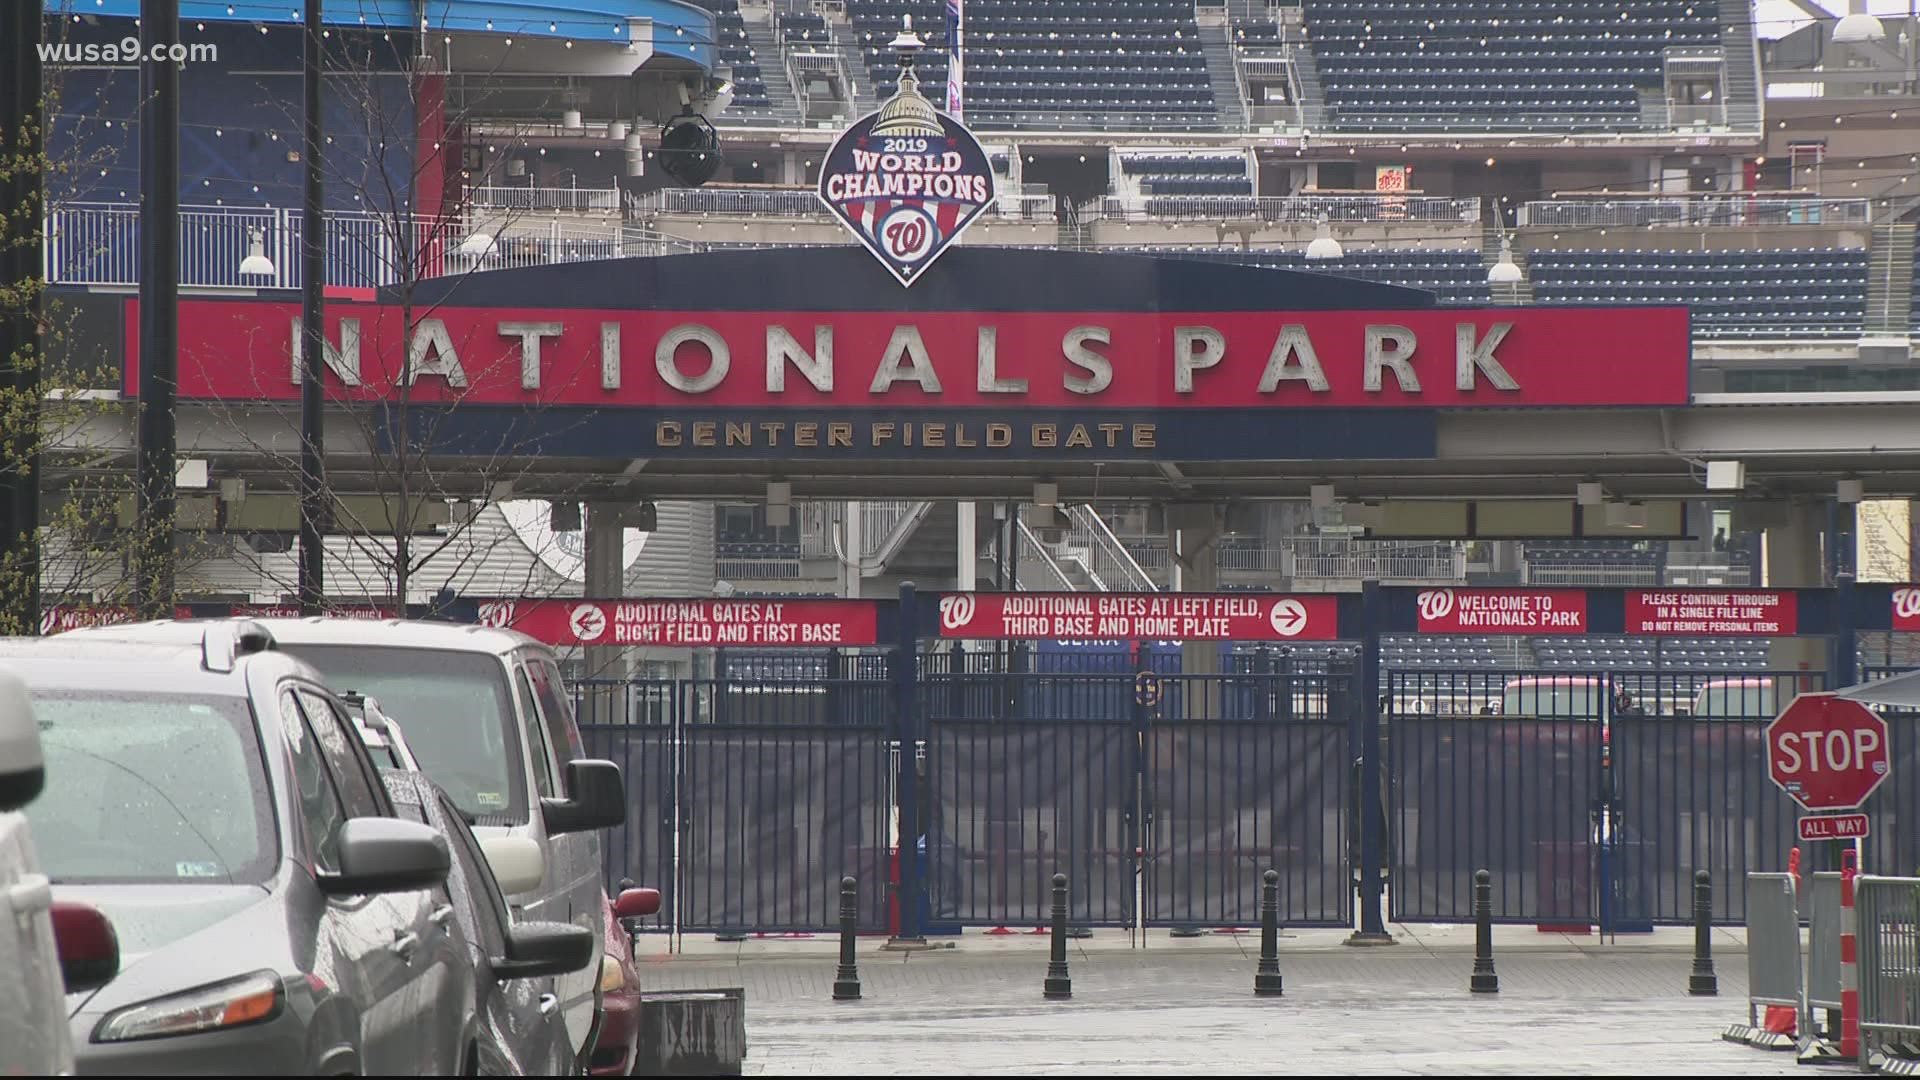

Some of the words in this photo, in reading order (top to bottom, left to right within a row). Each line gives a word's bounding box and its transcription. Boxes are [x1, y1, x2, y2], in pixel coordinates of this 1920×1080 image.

[883, 138, 928, 153] 2019
[852, 149, 962, 173] WORLD
[827, 173, 988, 204] CHAMPIONS
[291, 318, 1115, 394] NATIONALS
[1173, 323, 1522, 394] PARK
[656, 420, 854, 448] CENTER
[871, 422, 1013, 448] FIELD
[1031, 422, 1157, 449] GATE
[1002, 597, 1094, 616] ADDITIONAL
[1098, 597, 1146, 616] GATES
[1150, 598, 1169, 616] AT
[1173, 598, 1210, 617] LEFT
[1214, 598, 1263, 619] FIELD,
[1458, 595, 1530, 611] WELCOME
[1534, 596, 1552, 611] TO
[1642, 594, 1679, 605] PLEASE
[1681, 594, 1730, 606] CONTINUE
[1732, 594, 1779, 606] THROUGH
[614, 603, 708, 623] ADDITIONAL
[712, 603, 761, 622] GATES
[764, 603, 783, 622] AT
[1458, 611, 1537, 626] NATIONALS
[1541, 611, 1580, 626] PARK
[1657, 607, 1668, 618] IN
[1670, 607, 1677, 618] A
[1680, 607, 1715, 619] SINGLE
[1717, 607, 1739, 619] FILE
[1741, 607, 1764, 619] LINE
[614, 623, 661, 642] RIGHT
[666, 623, 712, 642] FIELD
[717, 624, 749, 642] AND
[753, 624, 798, 642] FIRST
[802, 624, 841, 642] BASE
[1002, 616, 1049, 635] THIRD
[1054, 617, 1094, 635] BASE
[1098, 617, 1129, 635] AND
[1134, 618, 1179, 636] HOME
[1183, 618, 1230, 636] PLATE
[1642, 621, 1654, 631] DO
[1655, 621, 1672, 631] NOT
[1673, 621, 1708, 632] REMOVE
[1709, 622, 1752, 632] PERSONAL
[1753, 622, 1779, 632] ITEMS
[1777, 728, 1880, 774] STOP
[1805, 821, 1830, 836] ALL
[1835, 818, 1863, 834] WAY
